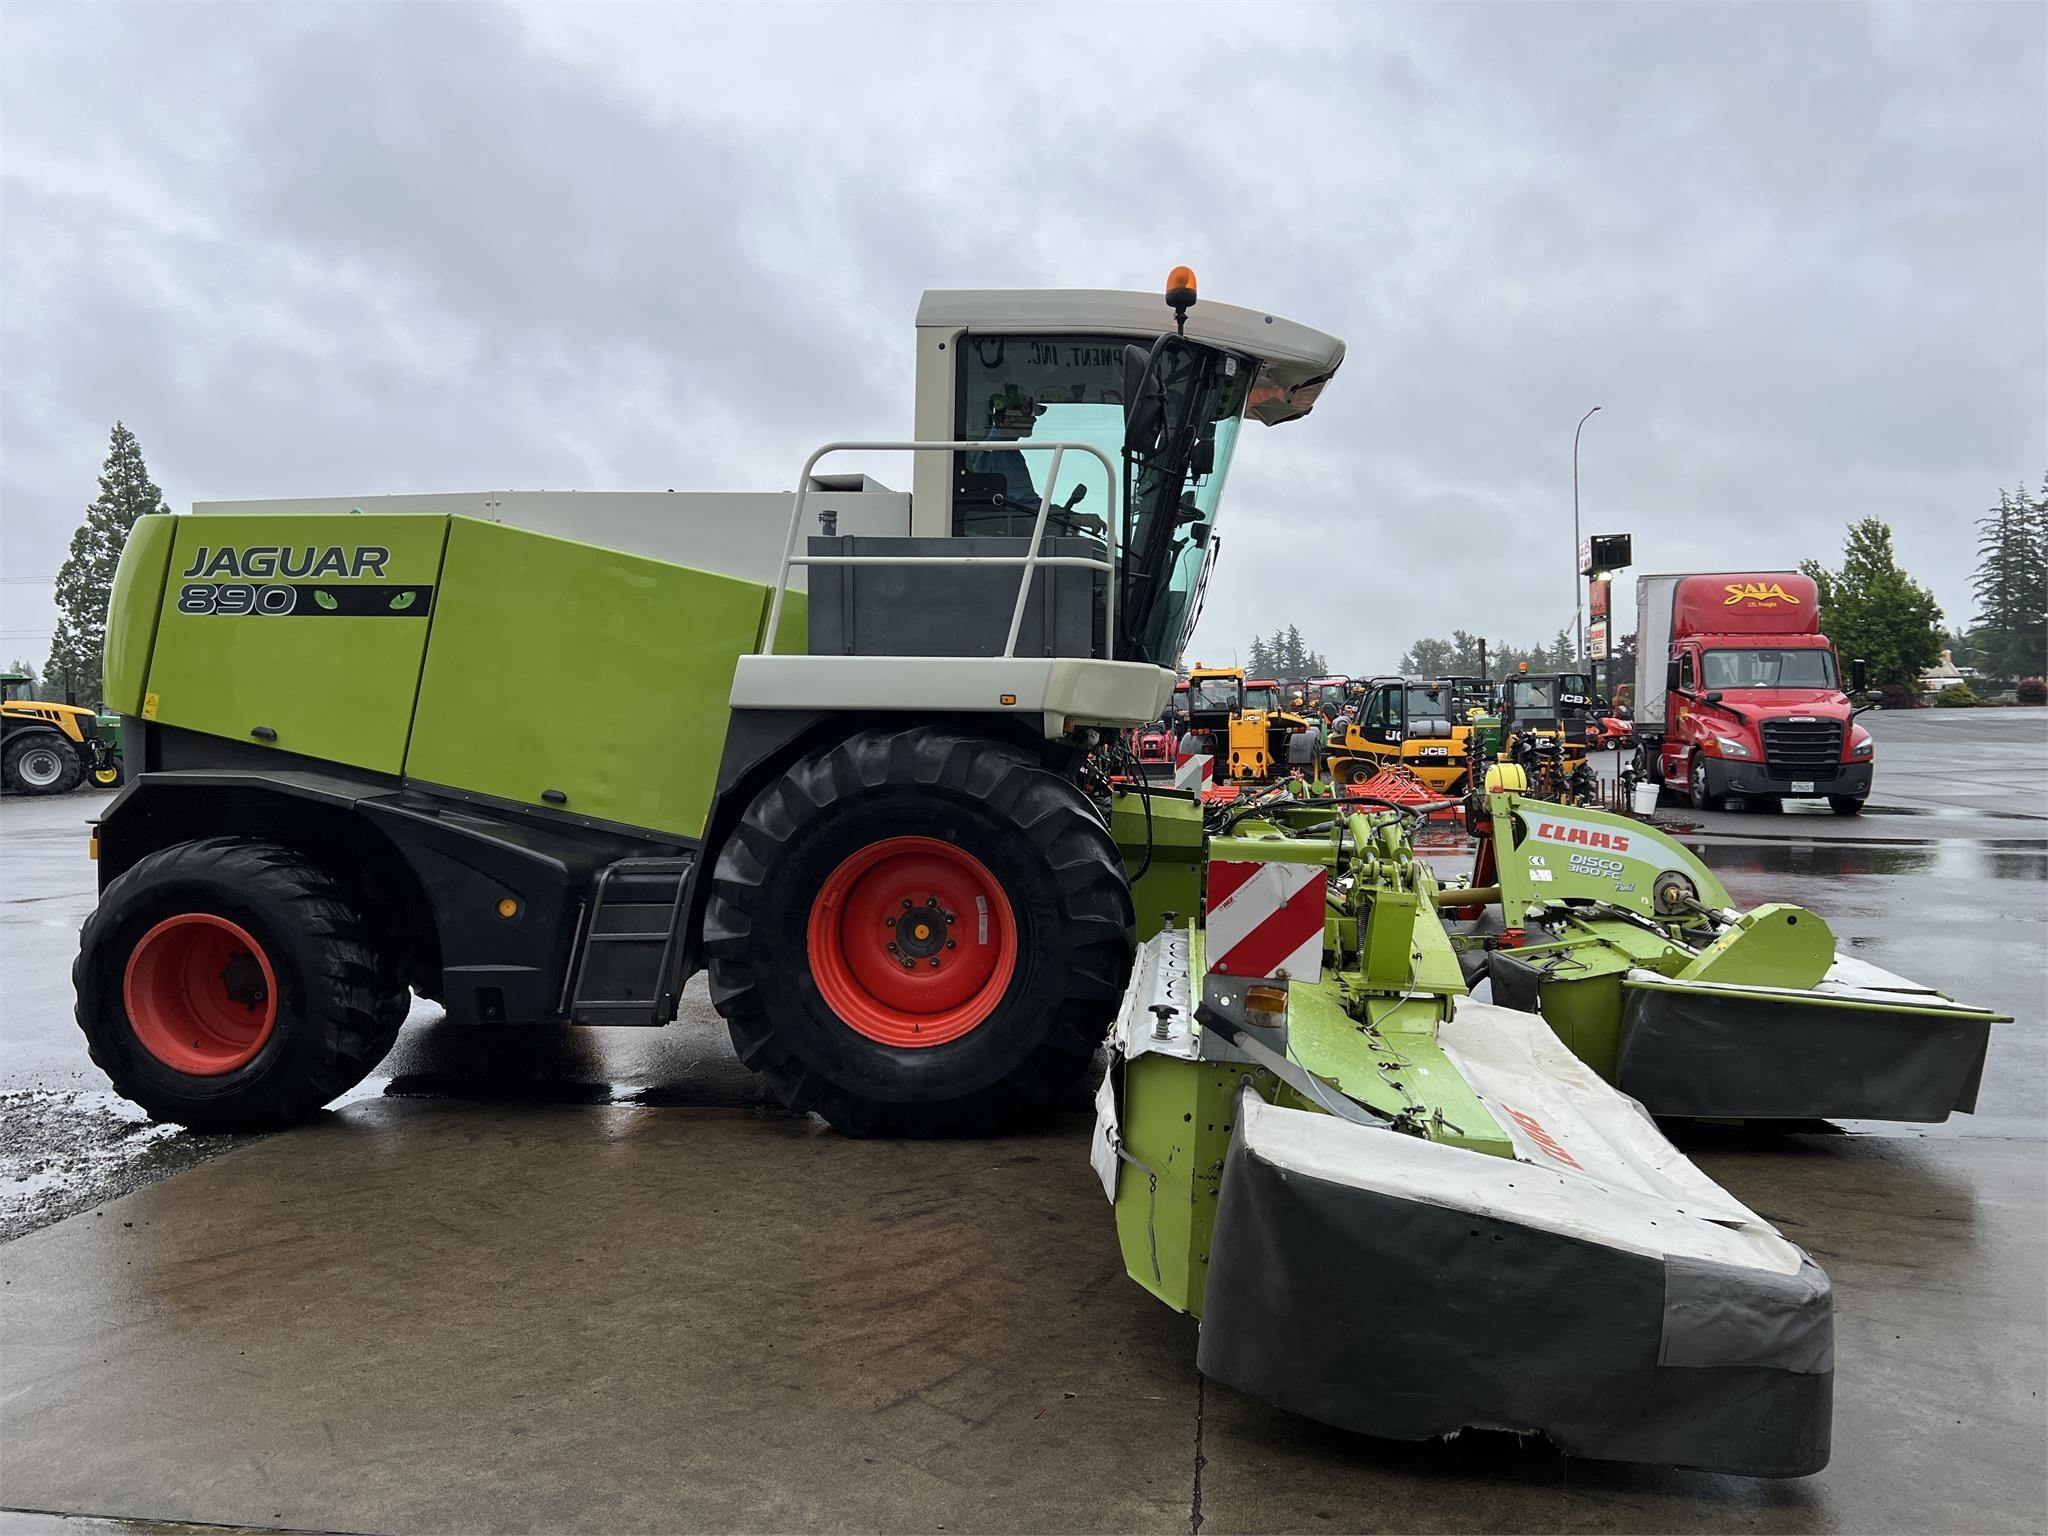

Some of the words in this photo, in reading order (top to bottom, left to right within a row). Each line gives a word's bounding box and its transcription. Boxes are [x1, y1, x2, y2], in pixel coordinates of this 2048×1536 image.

[184, 546, 390, 579] JAGUAR
[177, 583, 298, 616] 890
[1724, 583, 1800, 605] SAIA
[1560, 694, 1584, 704] JCB
[1419, 747, 1448, 756] JCB
[1537, 823, 1630, 852] CLAAS
[1568, 864, 1601, 876] 3100
[1569, 854, 1624, 871] DISCO
